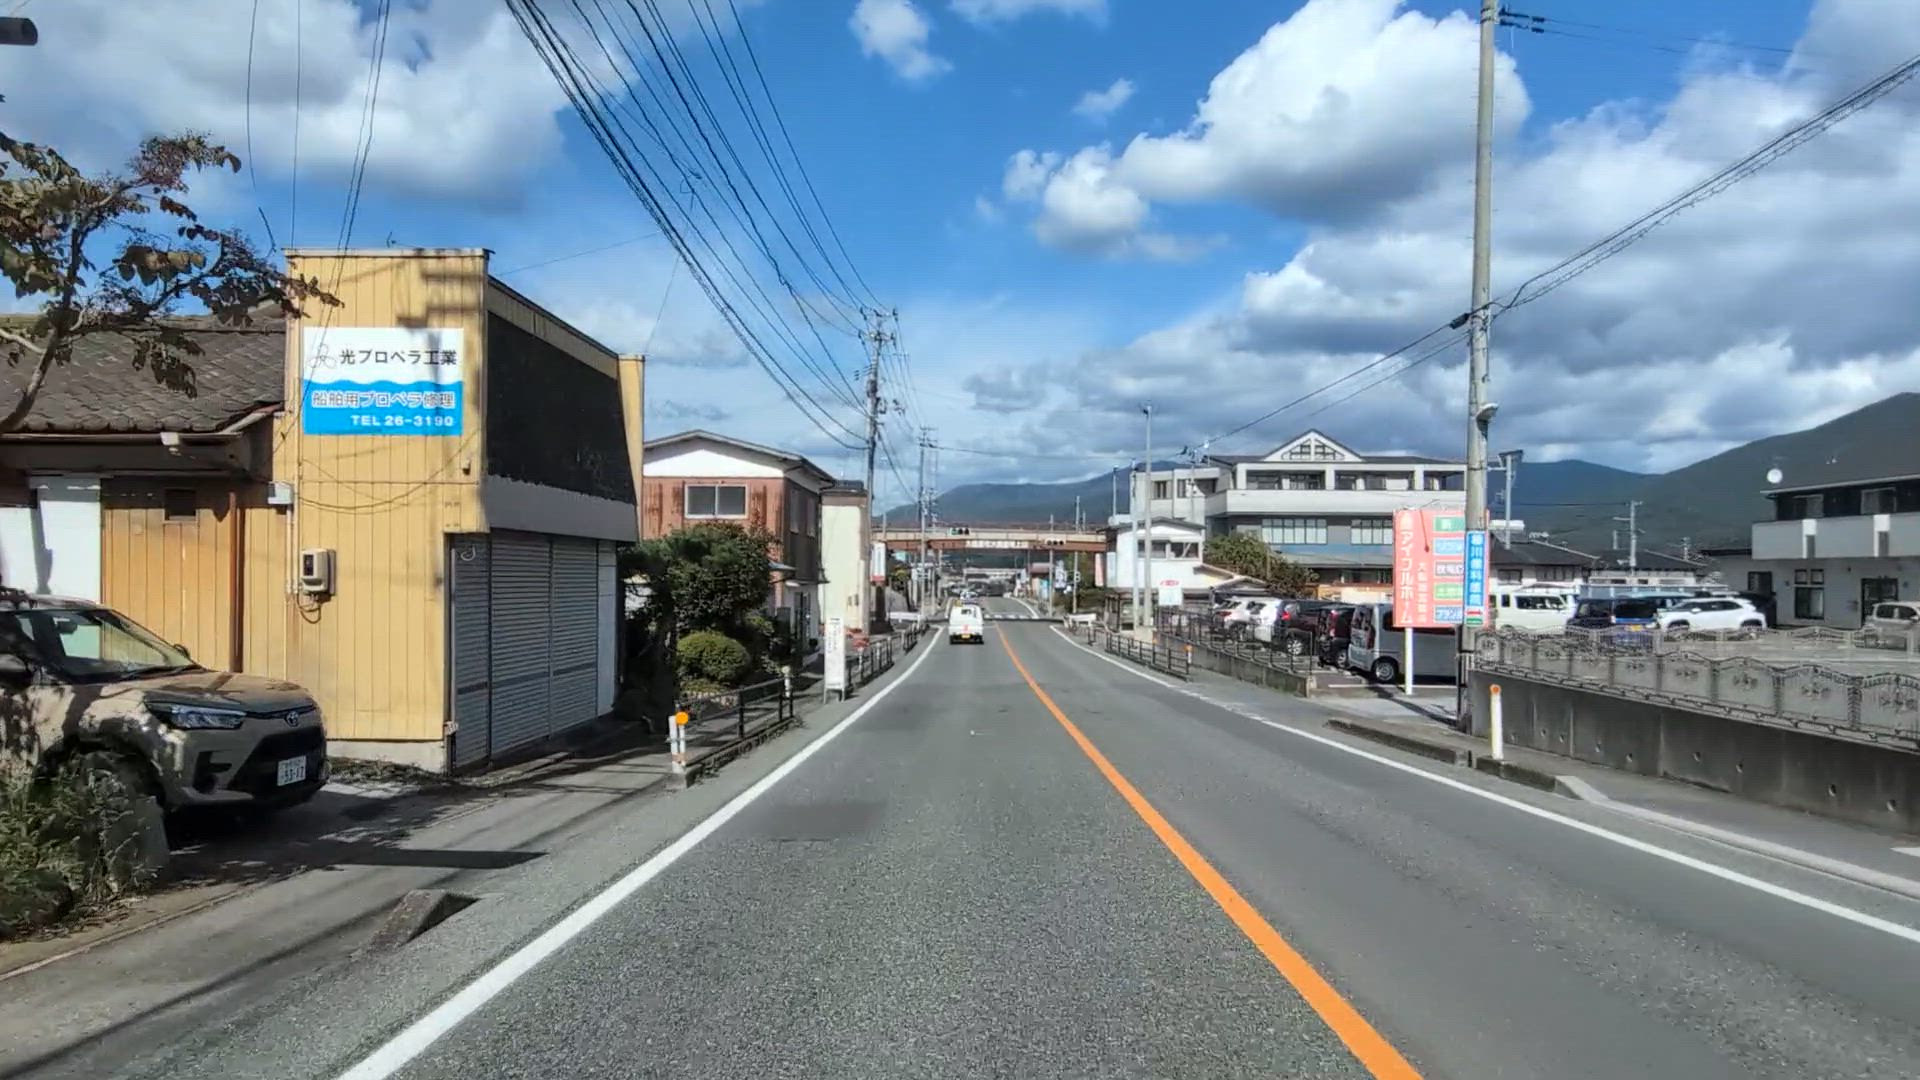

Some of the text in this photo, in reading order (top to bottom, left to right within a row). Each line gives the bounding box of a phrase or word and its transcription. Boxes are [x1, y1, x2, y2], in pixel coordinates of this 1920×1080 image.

[339, 349, 457, 366] 光プロペラ工業
[351, 415, 454, 427] TEL 26-3190
[1400, 531, 1414, 624] アイフルホーム
